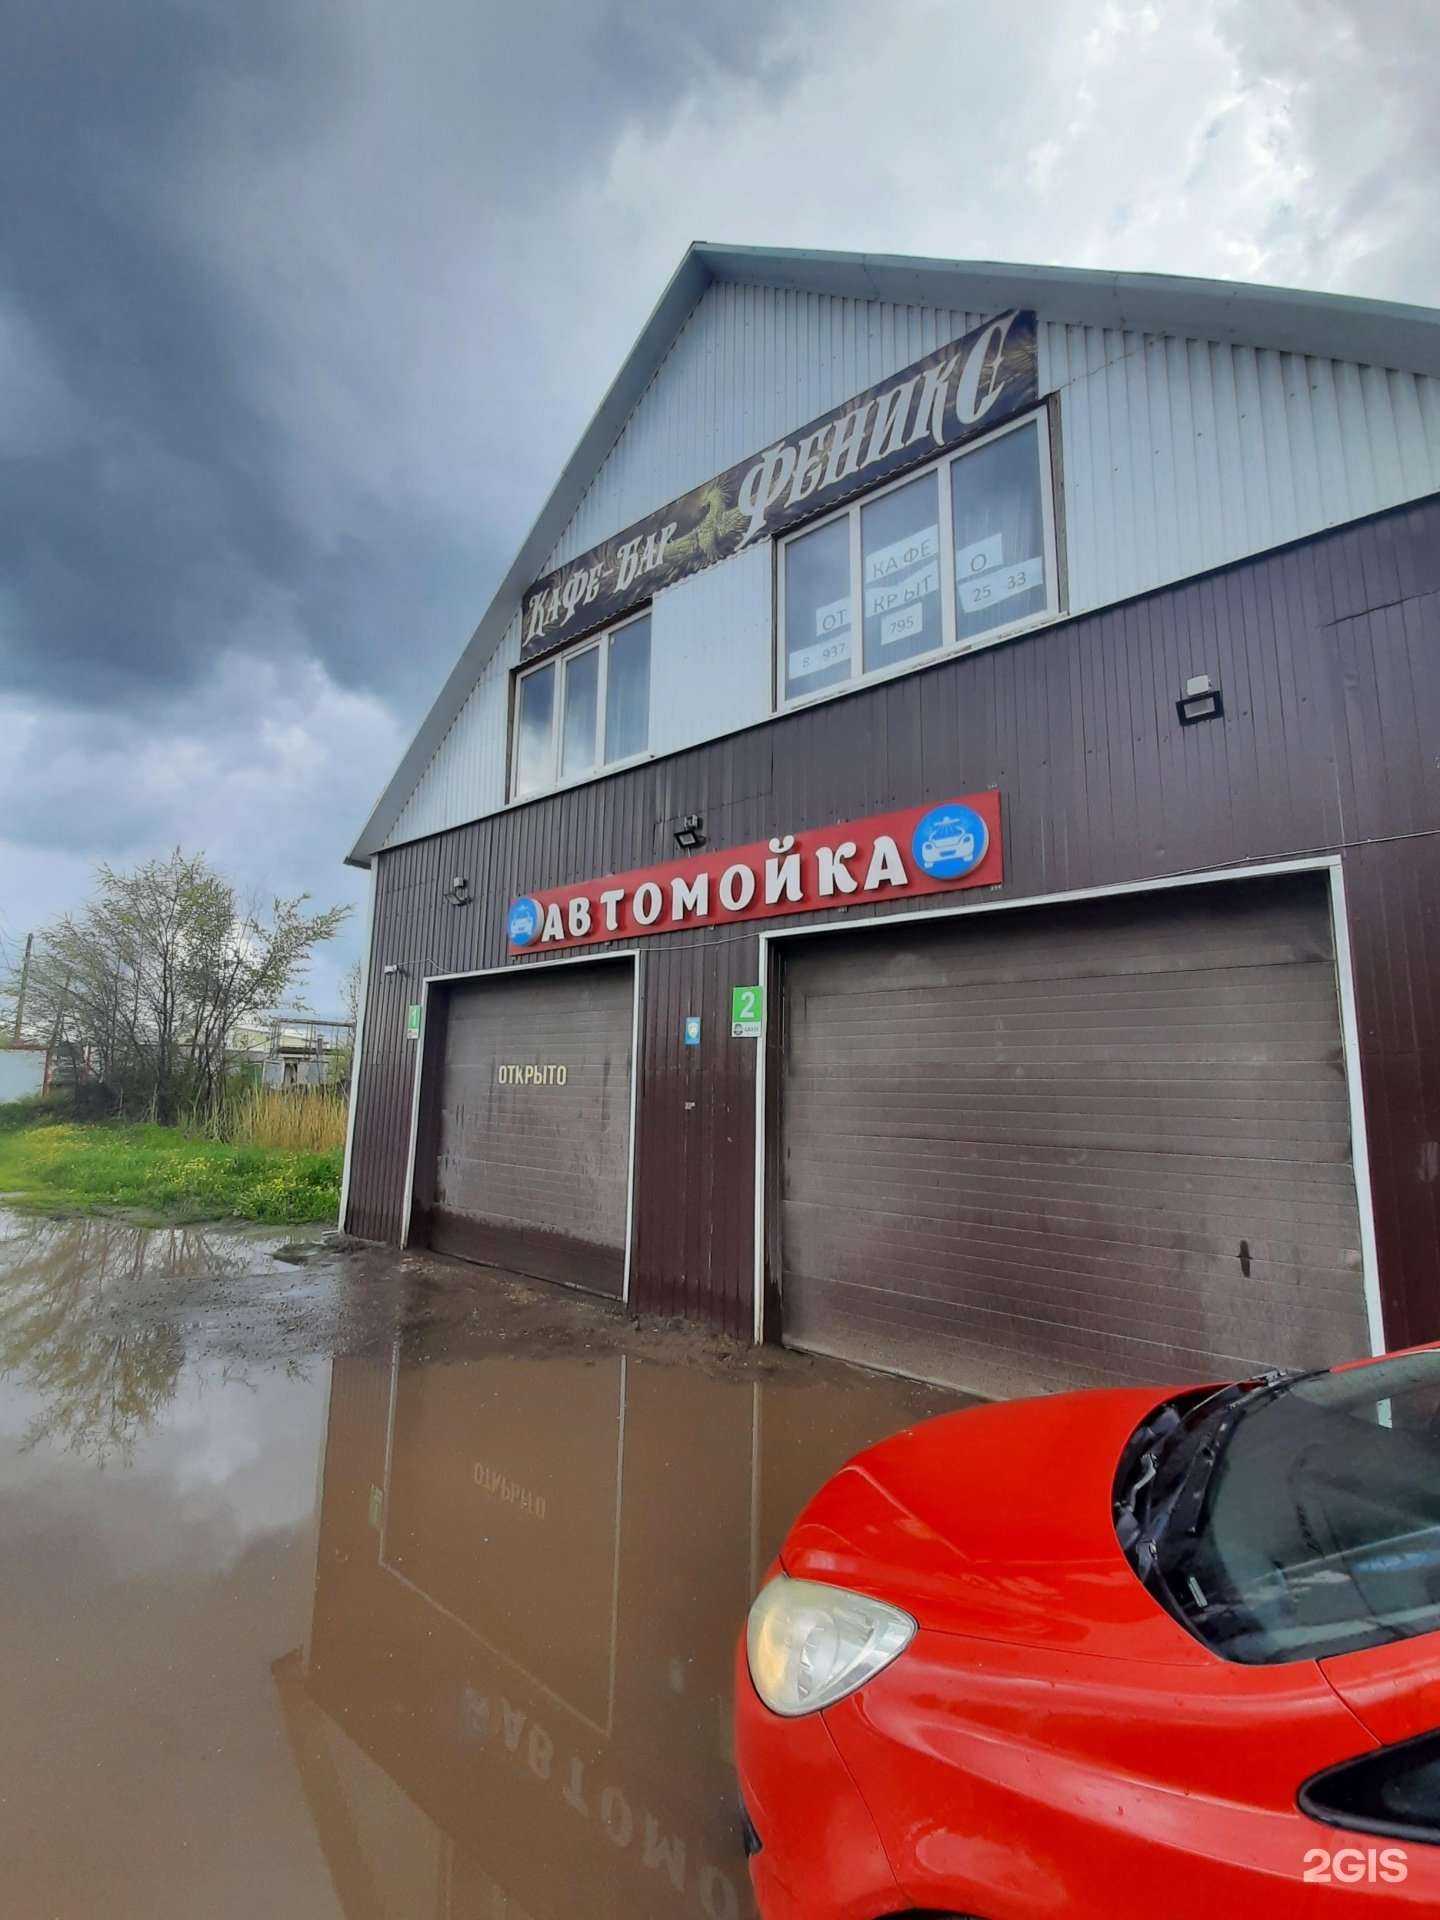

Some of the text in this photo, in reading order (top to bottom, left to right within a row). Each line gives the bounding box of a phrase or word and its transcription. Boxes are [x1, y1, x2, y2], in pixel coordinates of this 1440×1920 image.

[873, 539, 932, 577] КАФЕ
[973, 585, 992, 602] 25
[1007, 571, 1026, 590] 33
[541, 835, 908, 943] АВТОМОЙКА
[739, 991, 755, 1018] 2
[498, 1065, 567, 1086] ОТКРЫТО
